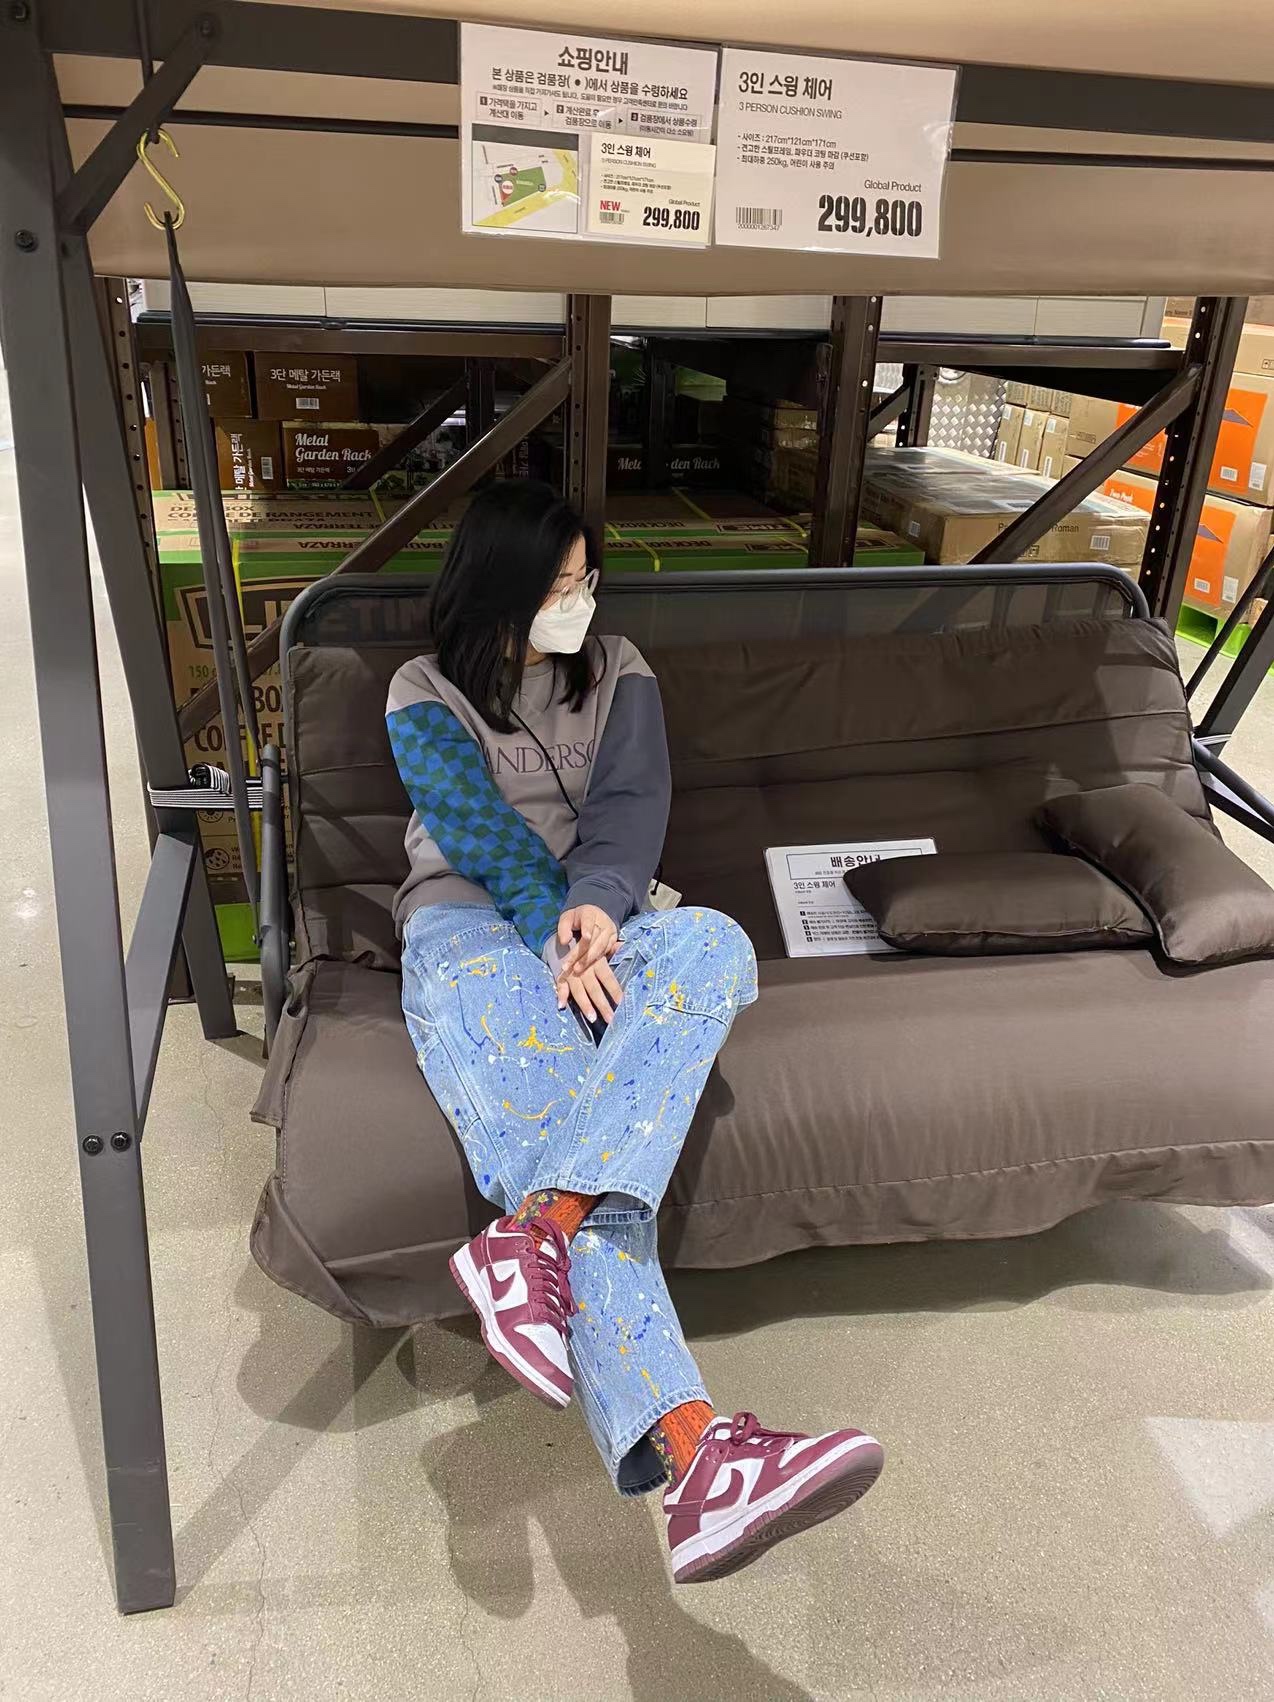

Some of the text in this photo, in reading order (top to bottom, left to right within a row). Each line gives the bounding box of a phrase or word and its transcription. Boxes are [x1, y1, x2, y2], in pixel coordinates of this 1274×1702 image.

[558, 46, 629, 75] 쇼핑안내
[492, 67, 502, 80] 본
[505, 68, 534, 84] 상품은
[610, 78, 639, 96] 상품을
[642, 83, 688, 100] 수령하세요
[738, 71, 833, 101] 3인 스윙 체어
[518, 101, 537, 111] 가지고
[739, 101, 843, 119] 3 PERSON CUSHION SWING
[510, 111, 524, 120] 이동
[742, 133, 760, 142] 사이즈
[601, 142, 615, 155] 3인
[616, 144, 634, 157] 스윙
[809, 160, 822, 169] 사용
[864, 179, 922, 193] Global Product
[600, 200, 621, 212] NEW
[643, 206, 701, 230] 299,800
[818, 194, 922, 237] 299,800
[201, 364, 231, 377] 가든랙
[270, 368, 341, 383] 3단 메탈 가든랙
[295, 433, 329, 446] Metal
[230, 433, 246, 485] 메탈 가든랙
[295, 447, 372, 463] Garden Rack
[666, 457, 691, 470] den
[1051, 523, 1080, 534] Roman
[189, 665, 209, 678] 150
[253, 685, 284, 713] BO
